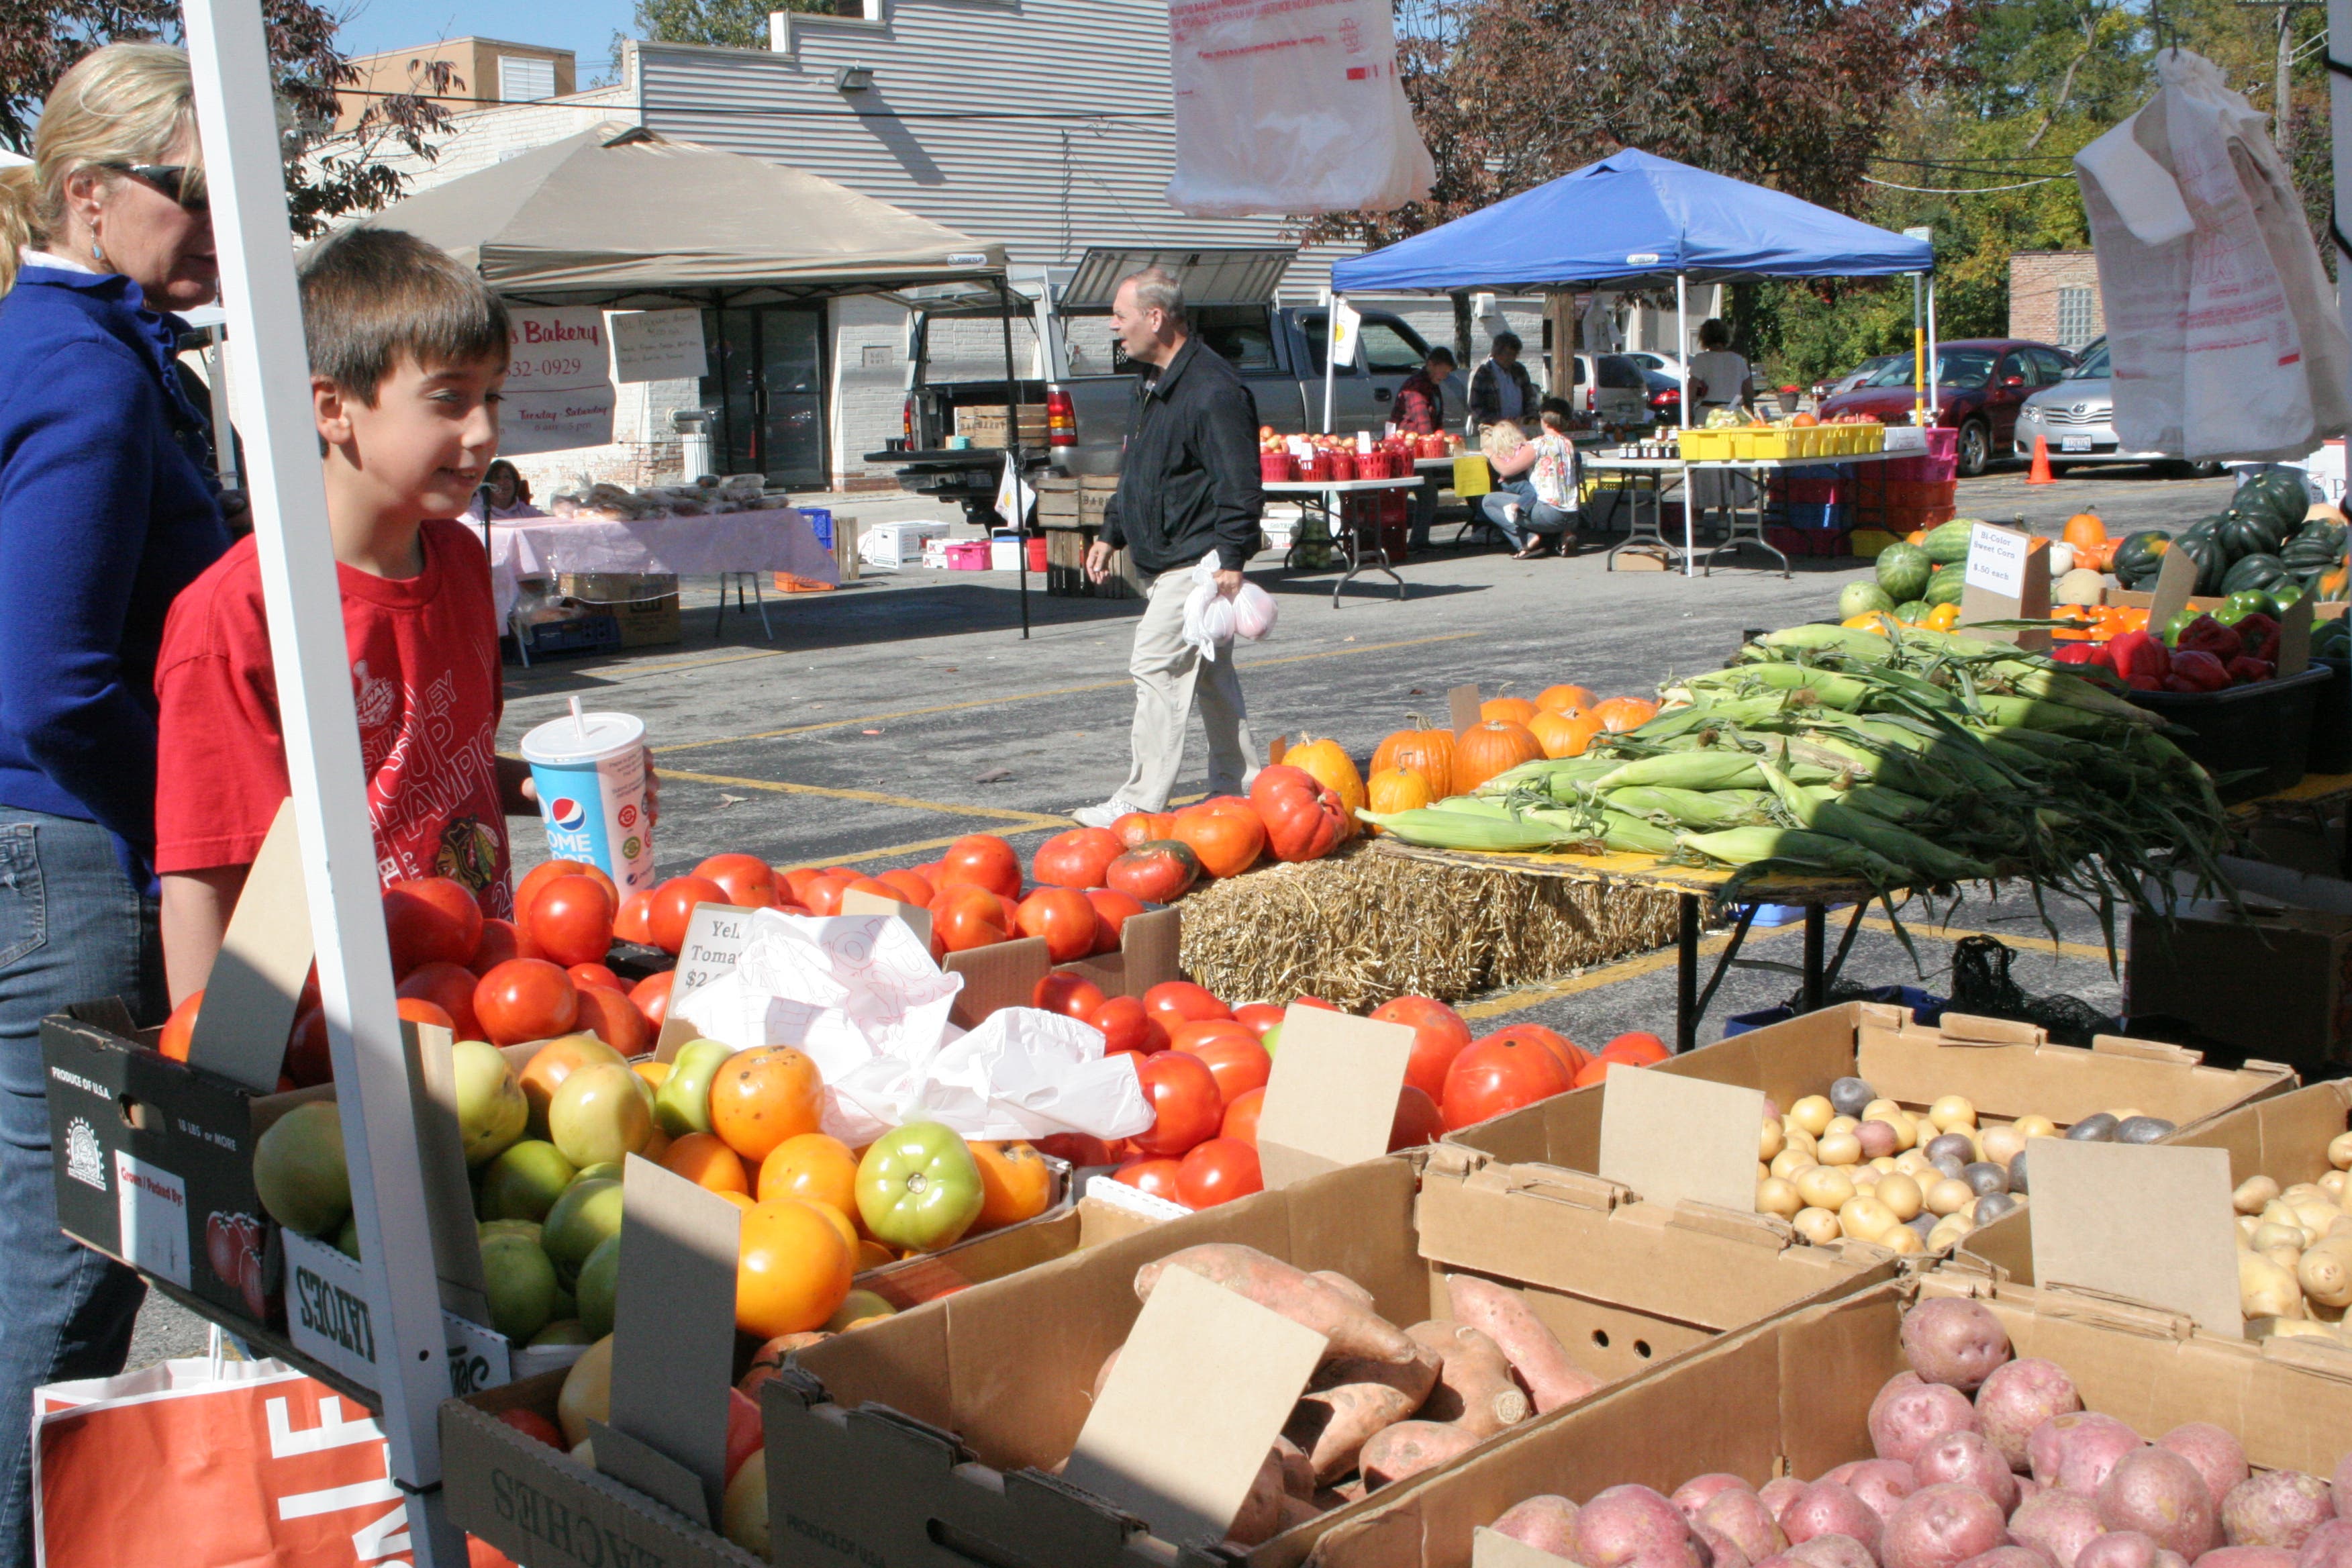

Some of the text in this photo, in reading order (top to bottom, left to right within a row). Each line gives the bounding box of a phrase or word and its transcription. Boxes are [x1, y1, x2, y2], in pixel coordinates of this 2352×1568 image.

[523, 319, 599, 346] Bakery
[518, 409, 558, 422] Tuesday
[565, 405, 608, 418] Saturday
[577, 421, 591, 432] pm
[1981, 532, 2011, 546] Bi-Color
[1974, 541, 2015, 558] Sweet Corn
[1973, 564, 2009, 580] $.50 each
[685, 969, 717, 988] $2
[51, 1066, 81, 1087] PRODUCE
[82, 1077, 92, 1091] OF
[187, 1122, 201, 1137] LBS
[204, 1131, 213, 1142] or
[214, 1132, 237, 1152] MORE
[121, 1166, 143, 1188] Grown
[146, 1176, 171, 1200] Packed
[296, 1265, 377, 1365] ATOES
